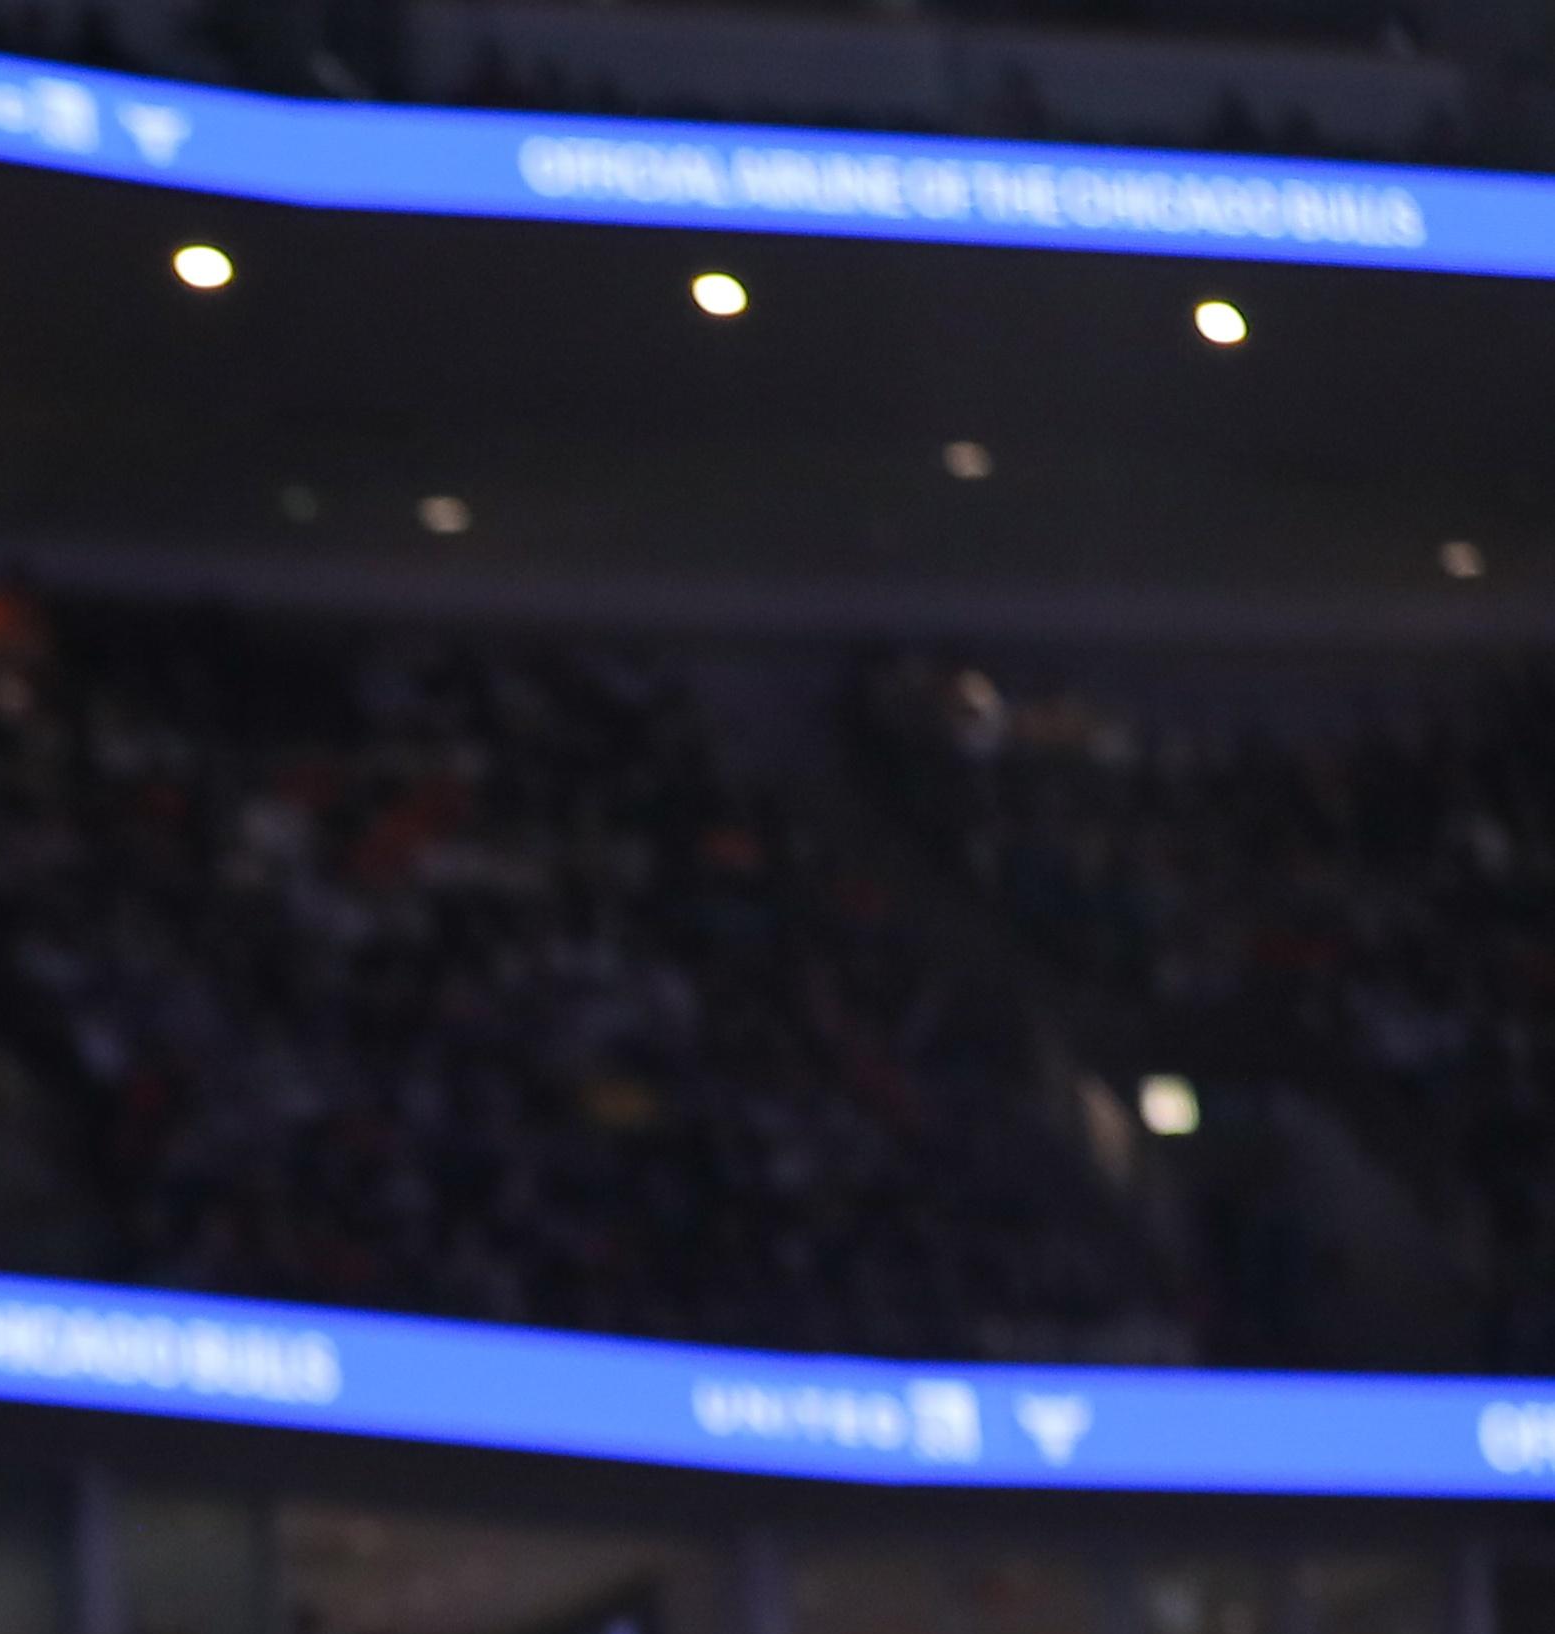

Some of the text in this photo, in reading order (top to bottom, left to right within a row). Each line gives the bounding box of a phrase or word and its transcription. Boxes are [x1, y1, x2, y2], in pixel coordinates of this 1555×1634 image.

[518, 136, 729, 208] OFFICIAL
[901, 157, 972, 221] OF
[972, 160, 1063, 229] THE
[1055, 167, 1287, 239] CHICAGO
[1282, 179, 1427, 248] BULLS
